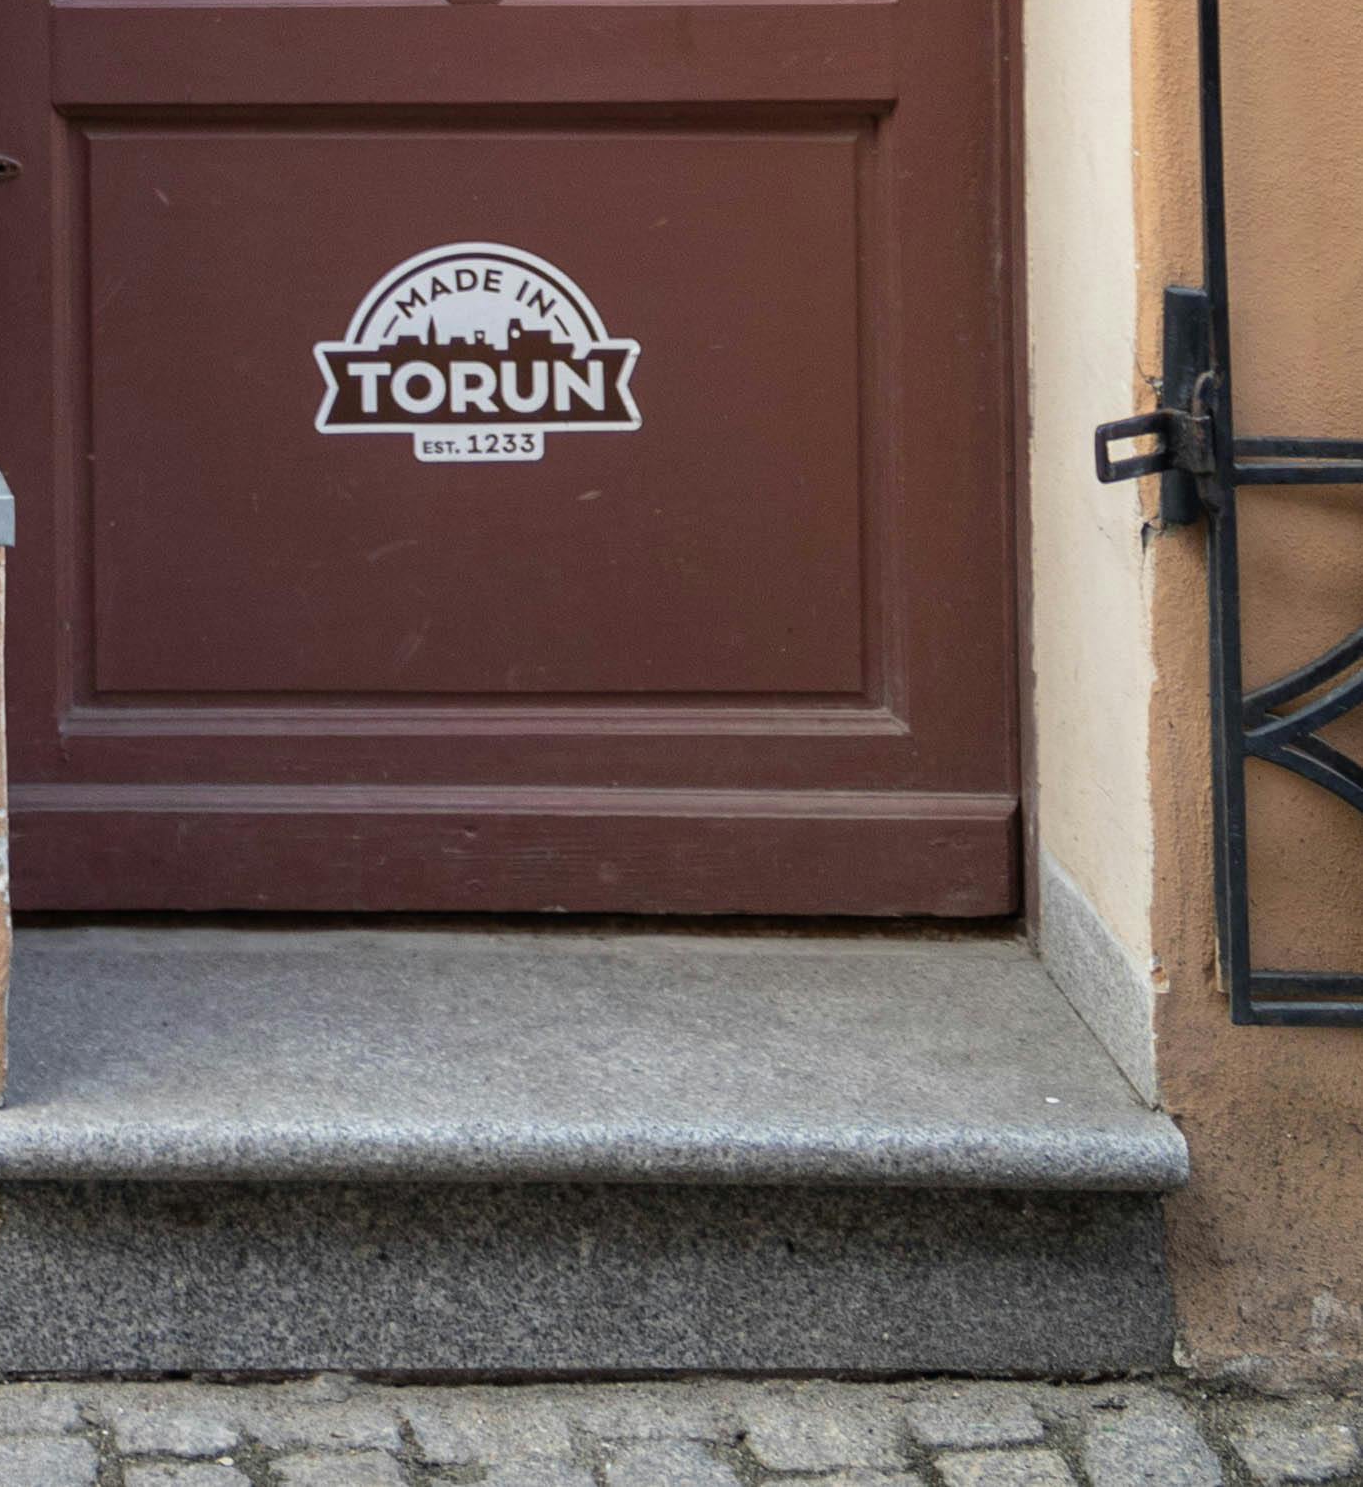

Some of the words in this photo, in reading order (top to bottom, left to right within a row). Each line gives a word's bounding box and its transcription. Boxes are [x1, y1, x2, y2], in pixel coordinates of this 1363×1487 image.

[394, 268, 504, 320] MADE
[515, 279, 557, 319] IN
[347, 359, 606, 414] TORUN
[422, 441, 461, 454] EST.
[466, 432, 536, 454] 1233
